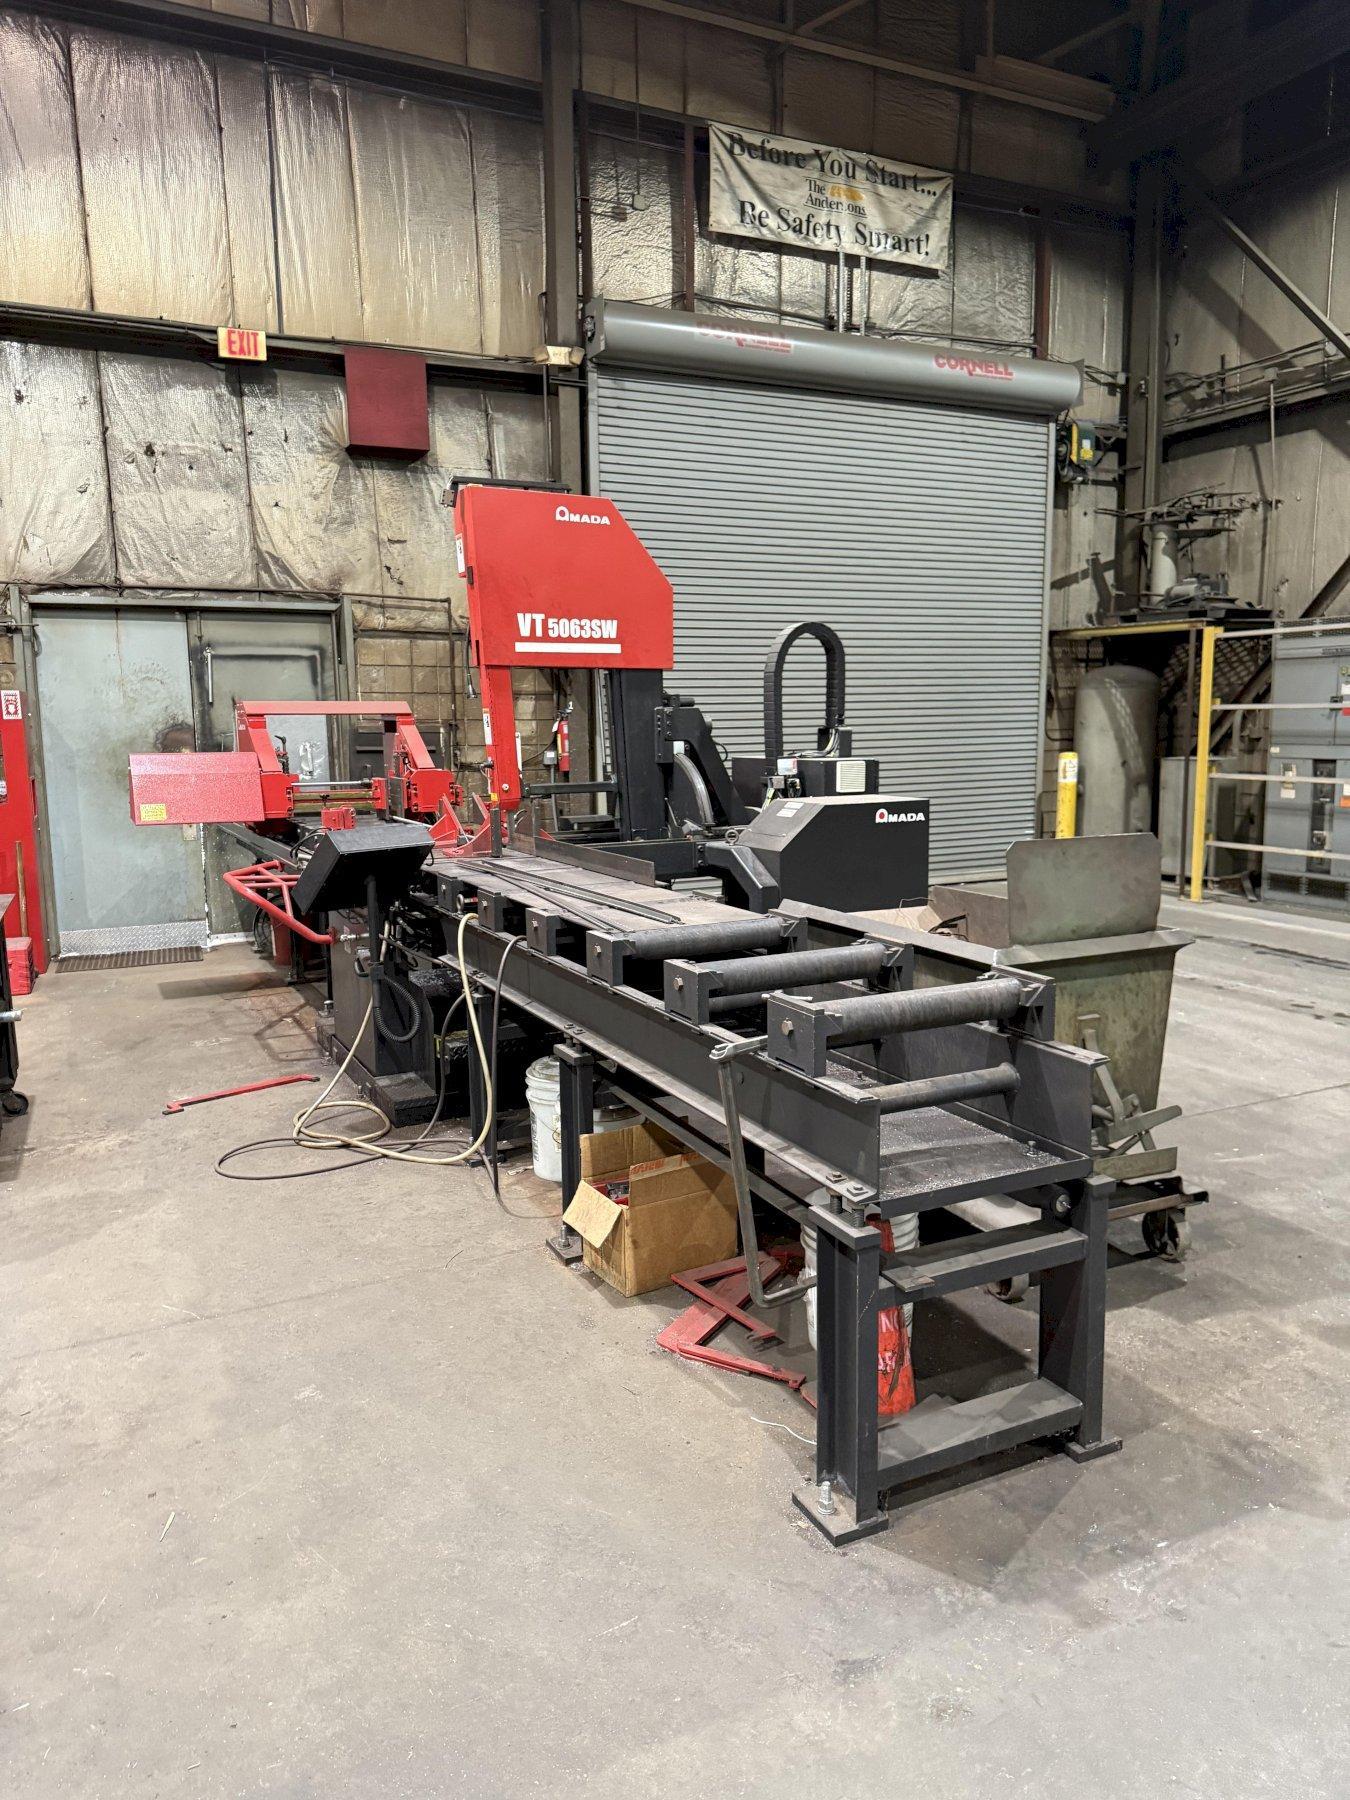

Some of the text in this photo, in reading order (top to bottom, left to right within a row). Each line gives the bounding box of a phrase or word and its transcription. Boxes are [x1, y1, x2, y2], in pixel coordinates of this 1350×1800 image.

[728, 131, 938, 197] Before You Start...
[805, 178, 827, 196] The
[804, 193, 868, 216] Anderons
[739, 200, 931, 257] Be Safety Smart!
[227, 329, 257, 357] EXIT
[934, 353, 1015, 377] CORNELL
[555, 505, 611, 526] AMADA
[516, 612, 619, 640] VT 5063SW
[875, 807, 926, 824] AMADA
